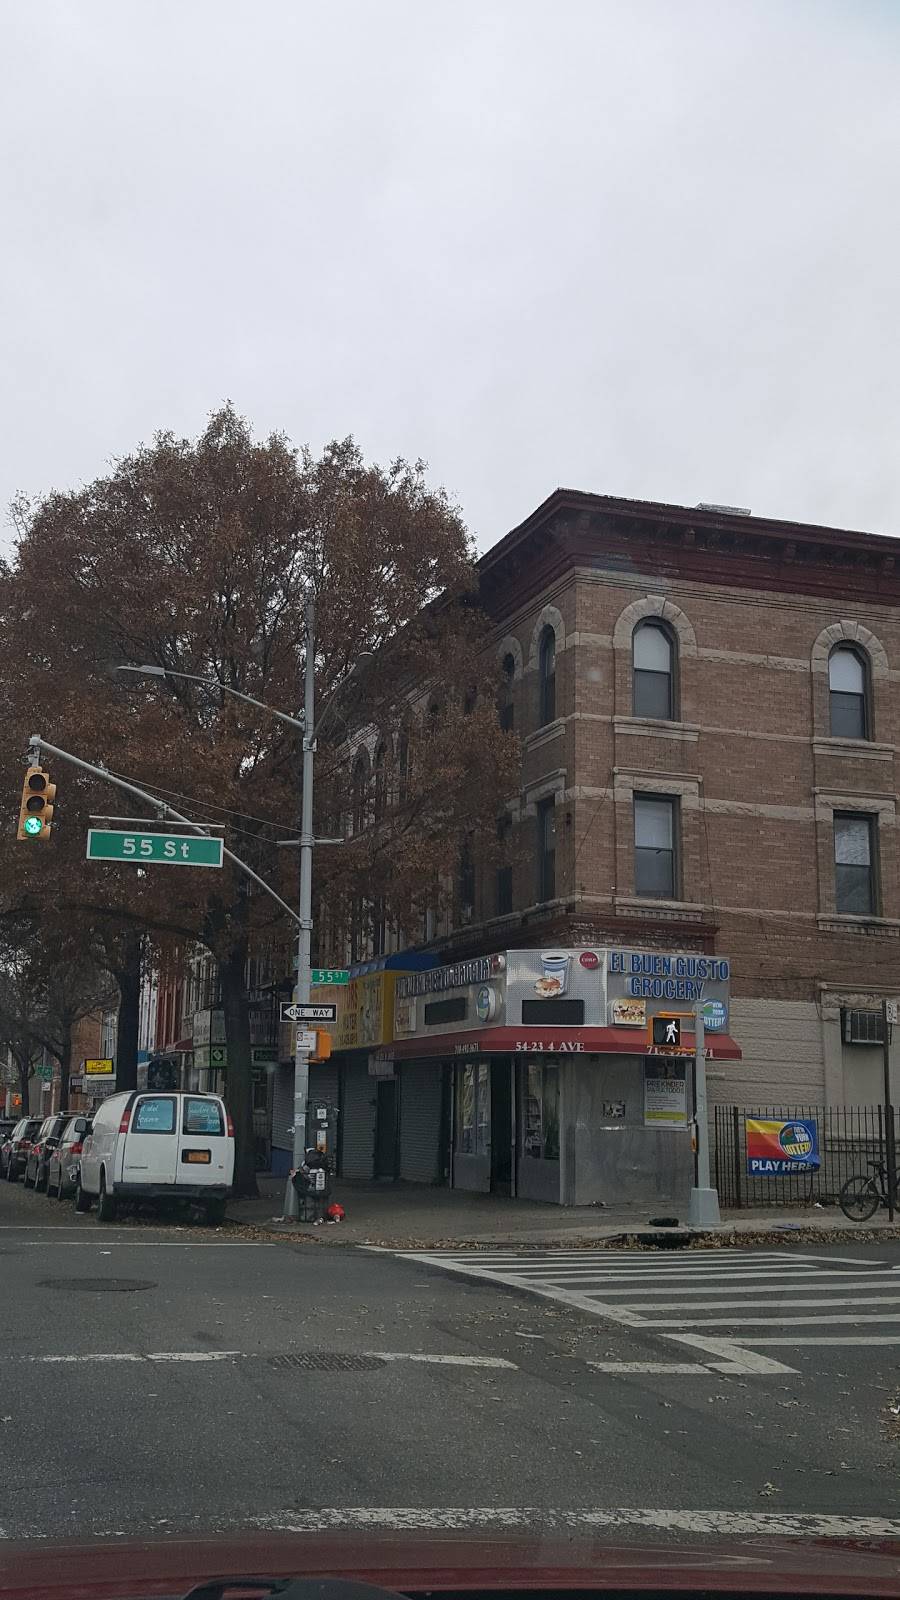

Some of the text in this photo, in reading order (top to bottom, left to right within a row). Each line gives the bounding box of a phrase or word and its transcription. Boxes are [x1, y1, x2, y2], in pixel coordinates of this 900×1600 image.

[123, 838, 190, 858] 55 St
[610, 951, 730, 981] EL BUEN GUSTO
[318, 971, 333, 982] 55
[630, 976, 705, 1001] GROCERY
[289, 1008, 330, 1017] ONE WAY
[703, 1016, 725, 1027] OTTERY
[515, 1041, 585, 1052] 54-23 4 AVE
[751, 1160, 780, 1171] PLAY
